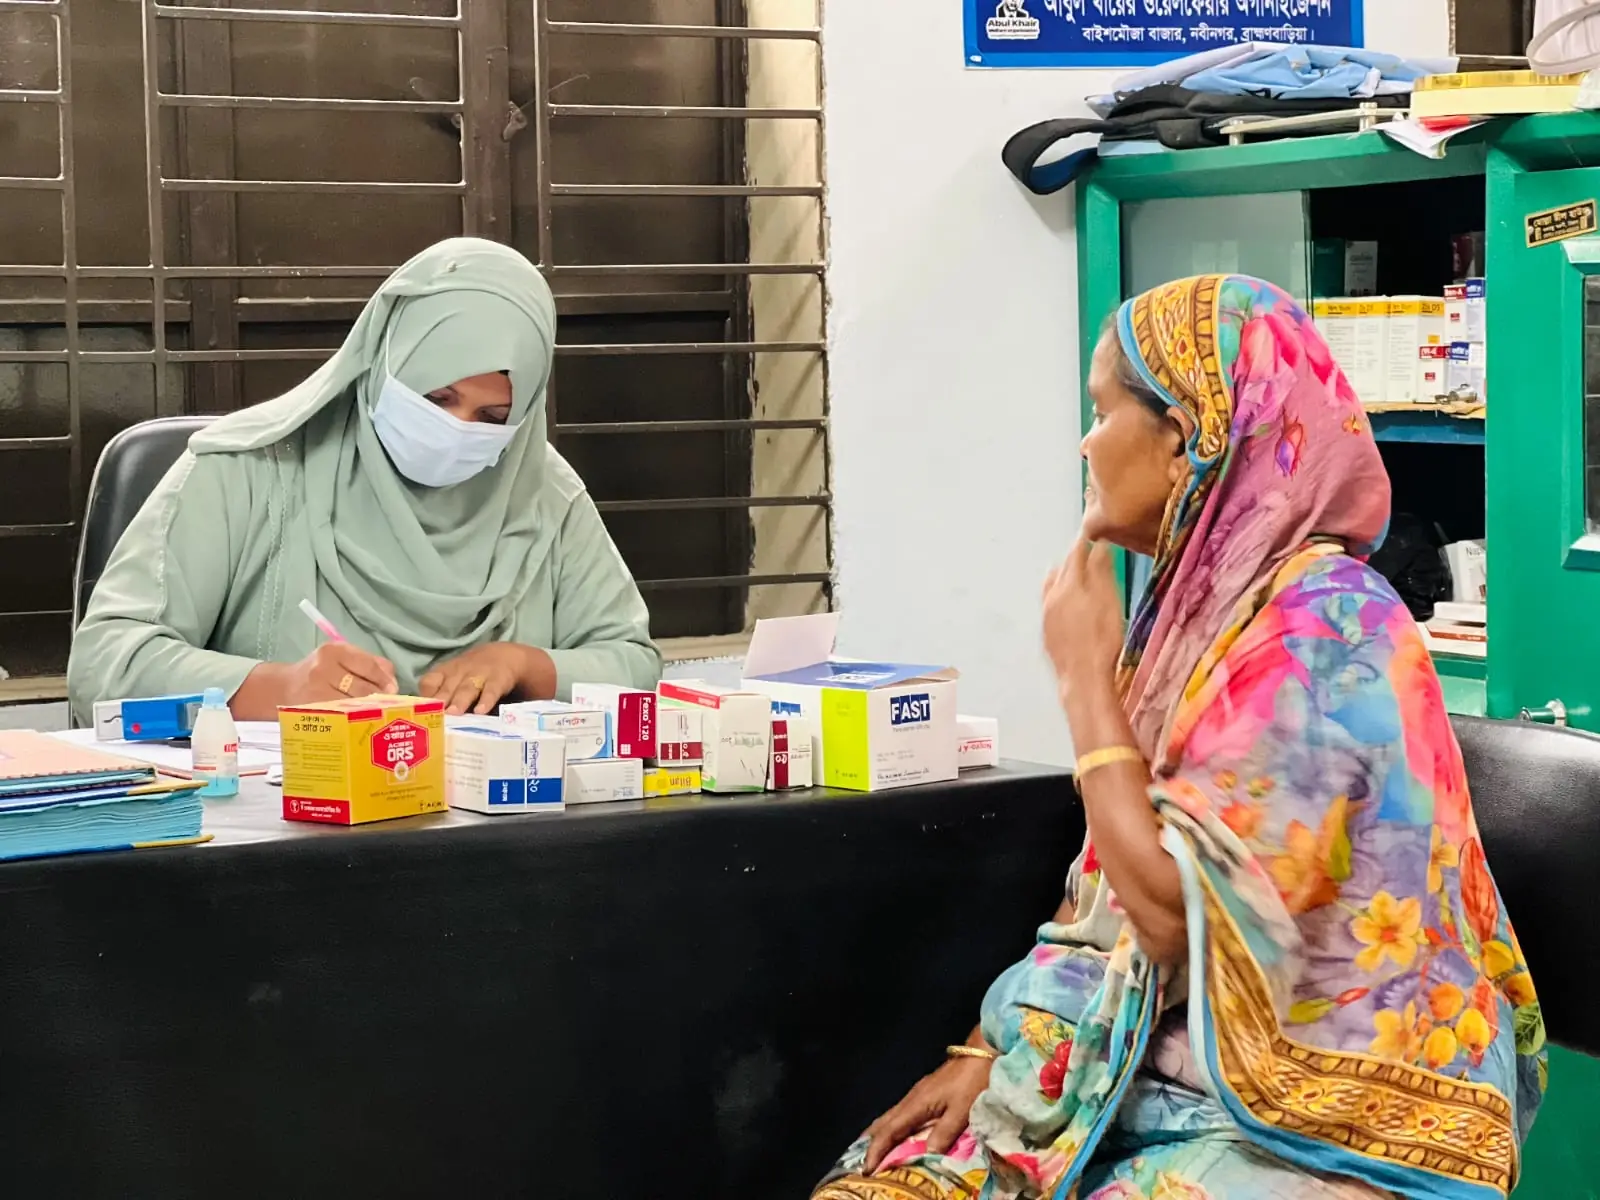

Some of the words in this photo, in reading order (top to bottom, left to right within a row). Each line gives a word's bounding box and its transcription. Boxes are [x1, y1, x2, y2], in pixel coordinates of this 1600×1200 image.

[1082, 24, 1144, 41] বাইশমৌজা
[1148, 27, 1186, 43] বাজার,
[1190, 23, 1238, 43] নবীনগর,
[891, 699, 929, 721] FAST
[642, 725, 650, 741] 120
[387, 747, 414, 762] ORS
